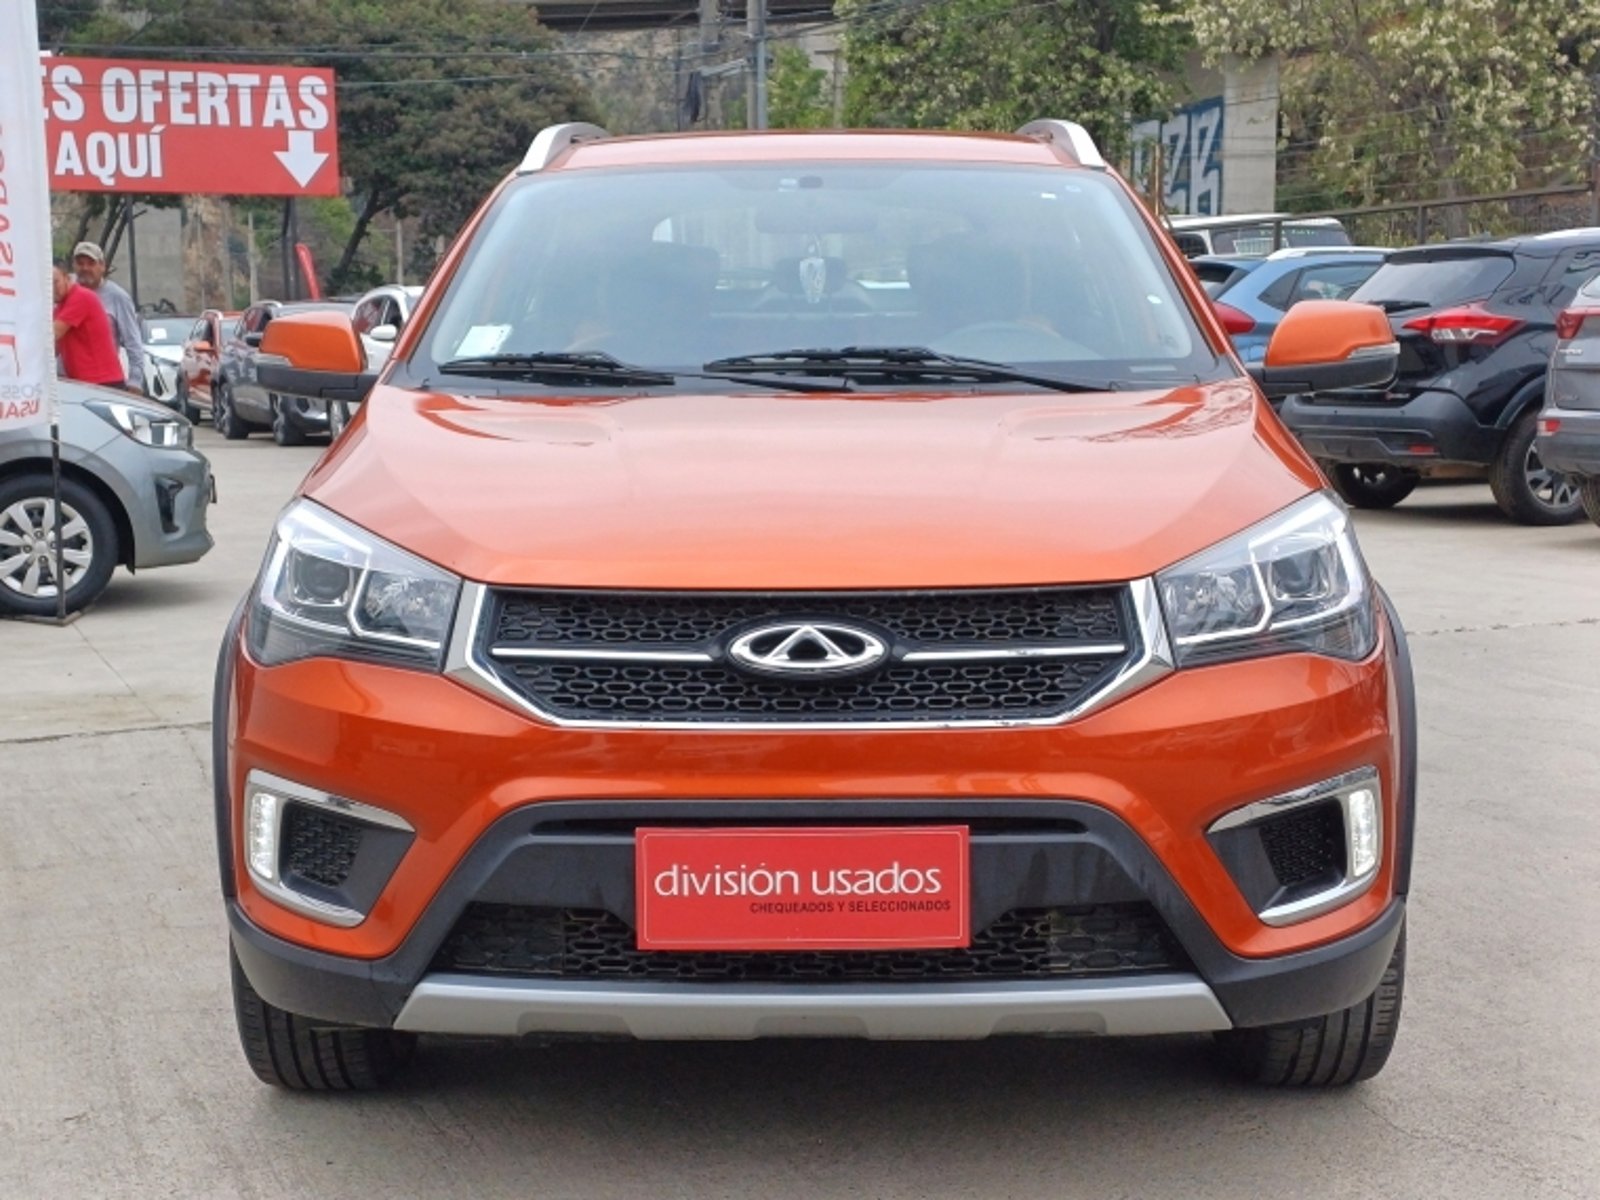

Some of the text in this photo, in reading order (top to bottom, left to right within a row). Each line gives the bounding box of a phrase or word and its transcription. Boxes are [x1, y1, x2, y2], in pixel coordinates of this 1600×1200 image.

[101, 66, 329, 130] OFERTAS
[54, 124, 166, 186] AQUÍ
[654, 861, 942, 897] división usados
[750, 900, 951, 914] CHEQUEADOS Y SELECCIONADOS
